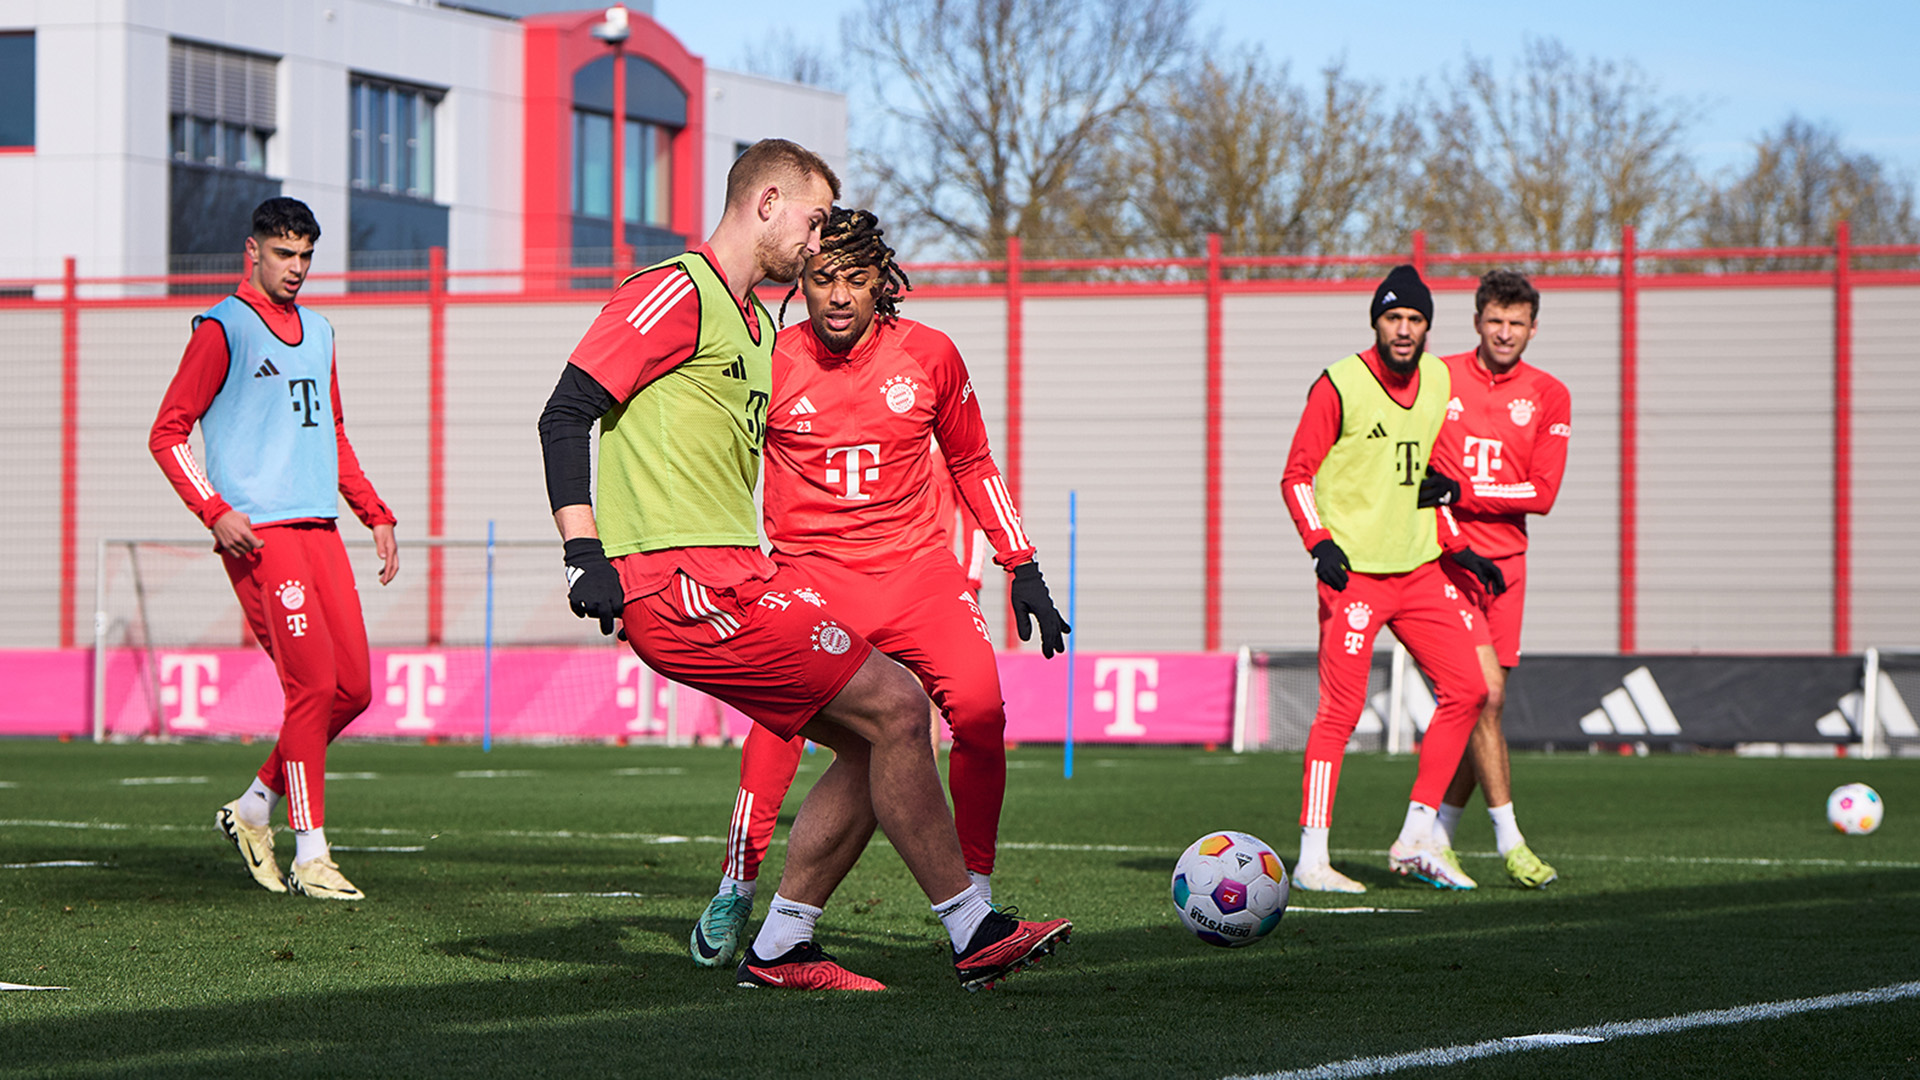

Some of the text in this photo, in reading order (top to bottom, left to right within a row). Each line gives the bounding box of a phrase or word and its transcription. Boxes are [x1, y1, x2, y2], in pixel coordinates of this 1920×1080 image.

[288, 379, 320, 427] T
[796, 420, 812, 433] 23
[825, 443, 881, 500] T
[1396, 441, 1420, 486] T
[1463, 435, 1503, 482] T
[757, 590, 792, 612] T
[286, 613, 308, 637] T
[1344, 631, 1365, 655] T
[161, 654, 220, 729] T
[386, 654, 446, 730] T
[1094, 658, 1158, 737] T
[1190, 907, 1251, 938] DERBYSTAR
